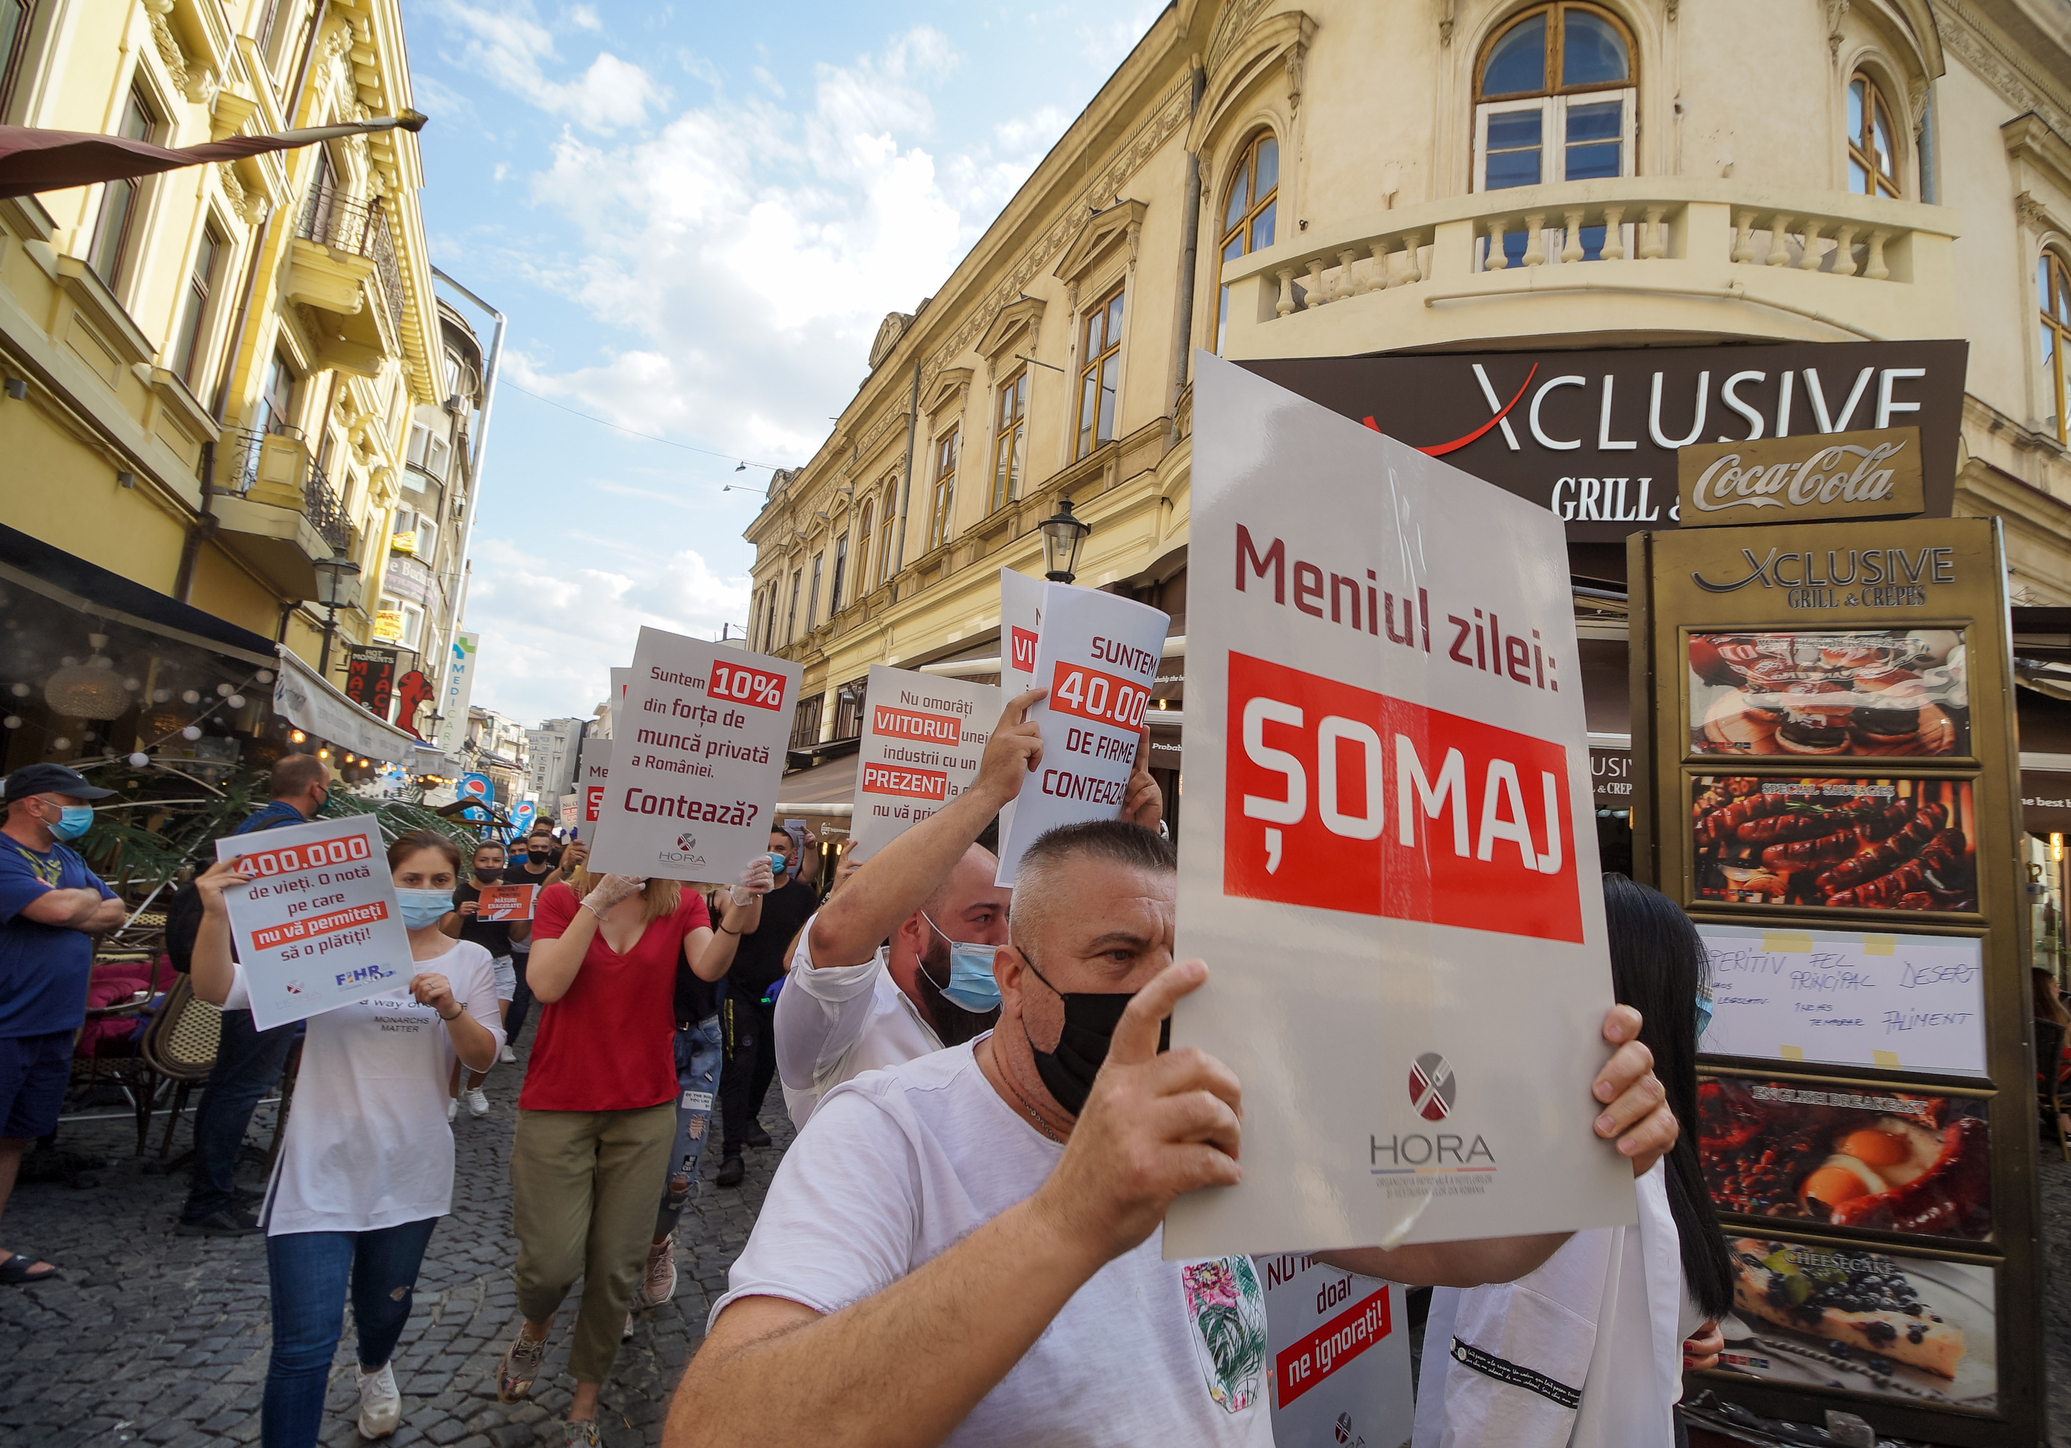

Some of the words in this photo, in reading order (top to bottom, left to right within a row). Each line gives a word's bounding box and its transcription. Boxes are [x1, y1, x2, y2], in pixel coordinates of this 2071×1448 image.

[1363, 363, 1926, 455] XCLUSIVE
[1692, 439, 1908, 512] Coca-Cola
[1551, 477, 1659, 521] GRILL
[1690, 547, 1955, 593] XCLUSIVE
[1235, 522, 1432, 656] Meniul
[1447, 608, 1559, 693] zilei:
[1787, 588, 1839, 609] GRILL
[1844, 593, 1859, 607] &
[1861, 586, 1926, 607] CREPES
[352, 653, 395, 664] MOMENTS
[1091, 636, 1158, 678] SUNTEM
[650, 666, 706, 690] Suntem
[713, 667, 781, 706] 10%
[443, 663, 465, 751] MEDICARE
[643, 697, 667, 715] din
[672, 698, 718, 728] forța
[723, 708, 746, 730] de
[900, 690, 920, 706] Nu
[922, 695, 973, 720] omorâți
[876, 712, 958, 741] VIITORUL
[961, 729, 989, 744] unei
[1066, 728, 1094, 755] DE
[637, 727, 702, 753] muncă
[705, 740, 770, 765] privată
[883, 744, 939, 766] industrii
[942, 755, 956, 768] cu
[960, 757, 977, 771] un
[589, 765, 609, 778] Me
[631, 755, 640, 767] a
[645, 755, 715, 779] României.
[864, 768, 945, 794] PREZENT
[947, 781, 958, 796] la
[1242, 696, 1563, 875] ȘOMAJ
[1762, 783, 1820, 795] SPECIAL
[1823, 784, 1896, 797] SAUSAGES
[624, 787, 759, 827] Contează?
[873, 804, 890, 817] nu
[894, 803, 910, 819] vă
[2035, 796, 2065, 808] best
[237, 836, 370, 876] 400.000
[658, 851, 706, 864] HORA
[249, 885, 269, 900] de
[274, 877, 315, 894] vieți.
[318, 873, 330, 885] O
[335, 865, 371, 882] notă
[287, 903, 307, 918] pe
[312, 892, 346, 909] care
[257, 930, 281, 946] nu
[283, 921, 304, 938] vă
[307, 904, 383, 938] permiteți
[280, 943, 300, 962] să
[304, 944, 314, 955] o
[319, 927, 372, 955] plătiți!
[1809, 952, 1855, 970] FEL
[374, 1016, 430, 1025] MONARCHS
[381, 1024, 420, 1033] MATTER
[1752, 1085, 1828, 1106] ENGLISH
[1830, 1092, 1928, 1115] BREAKFAST
[1370, 1134, 1496, 1165] HORA
[1267, 1255, 1296, 1291] NU
[1784, 1251, 1896, 1274] CHEESECAKE
[1316, 1272, 1353, 1315] doar
[1288, 1352, 1311, 1387] ne
[1315, 1299, 1383, 1374] ignorați!
